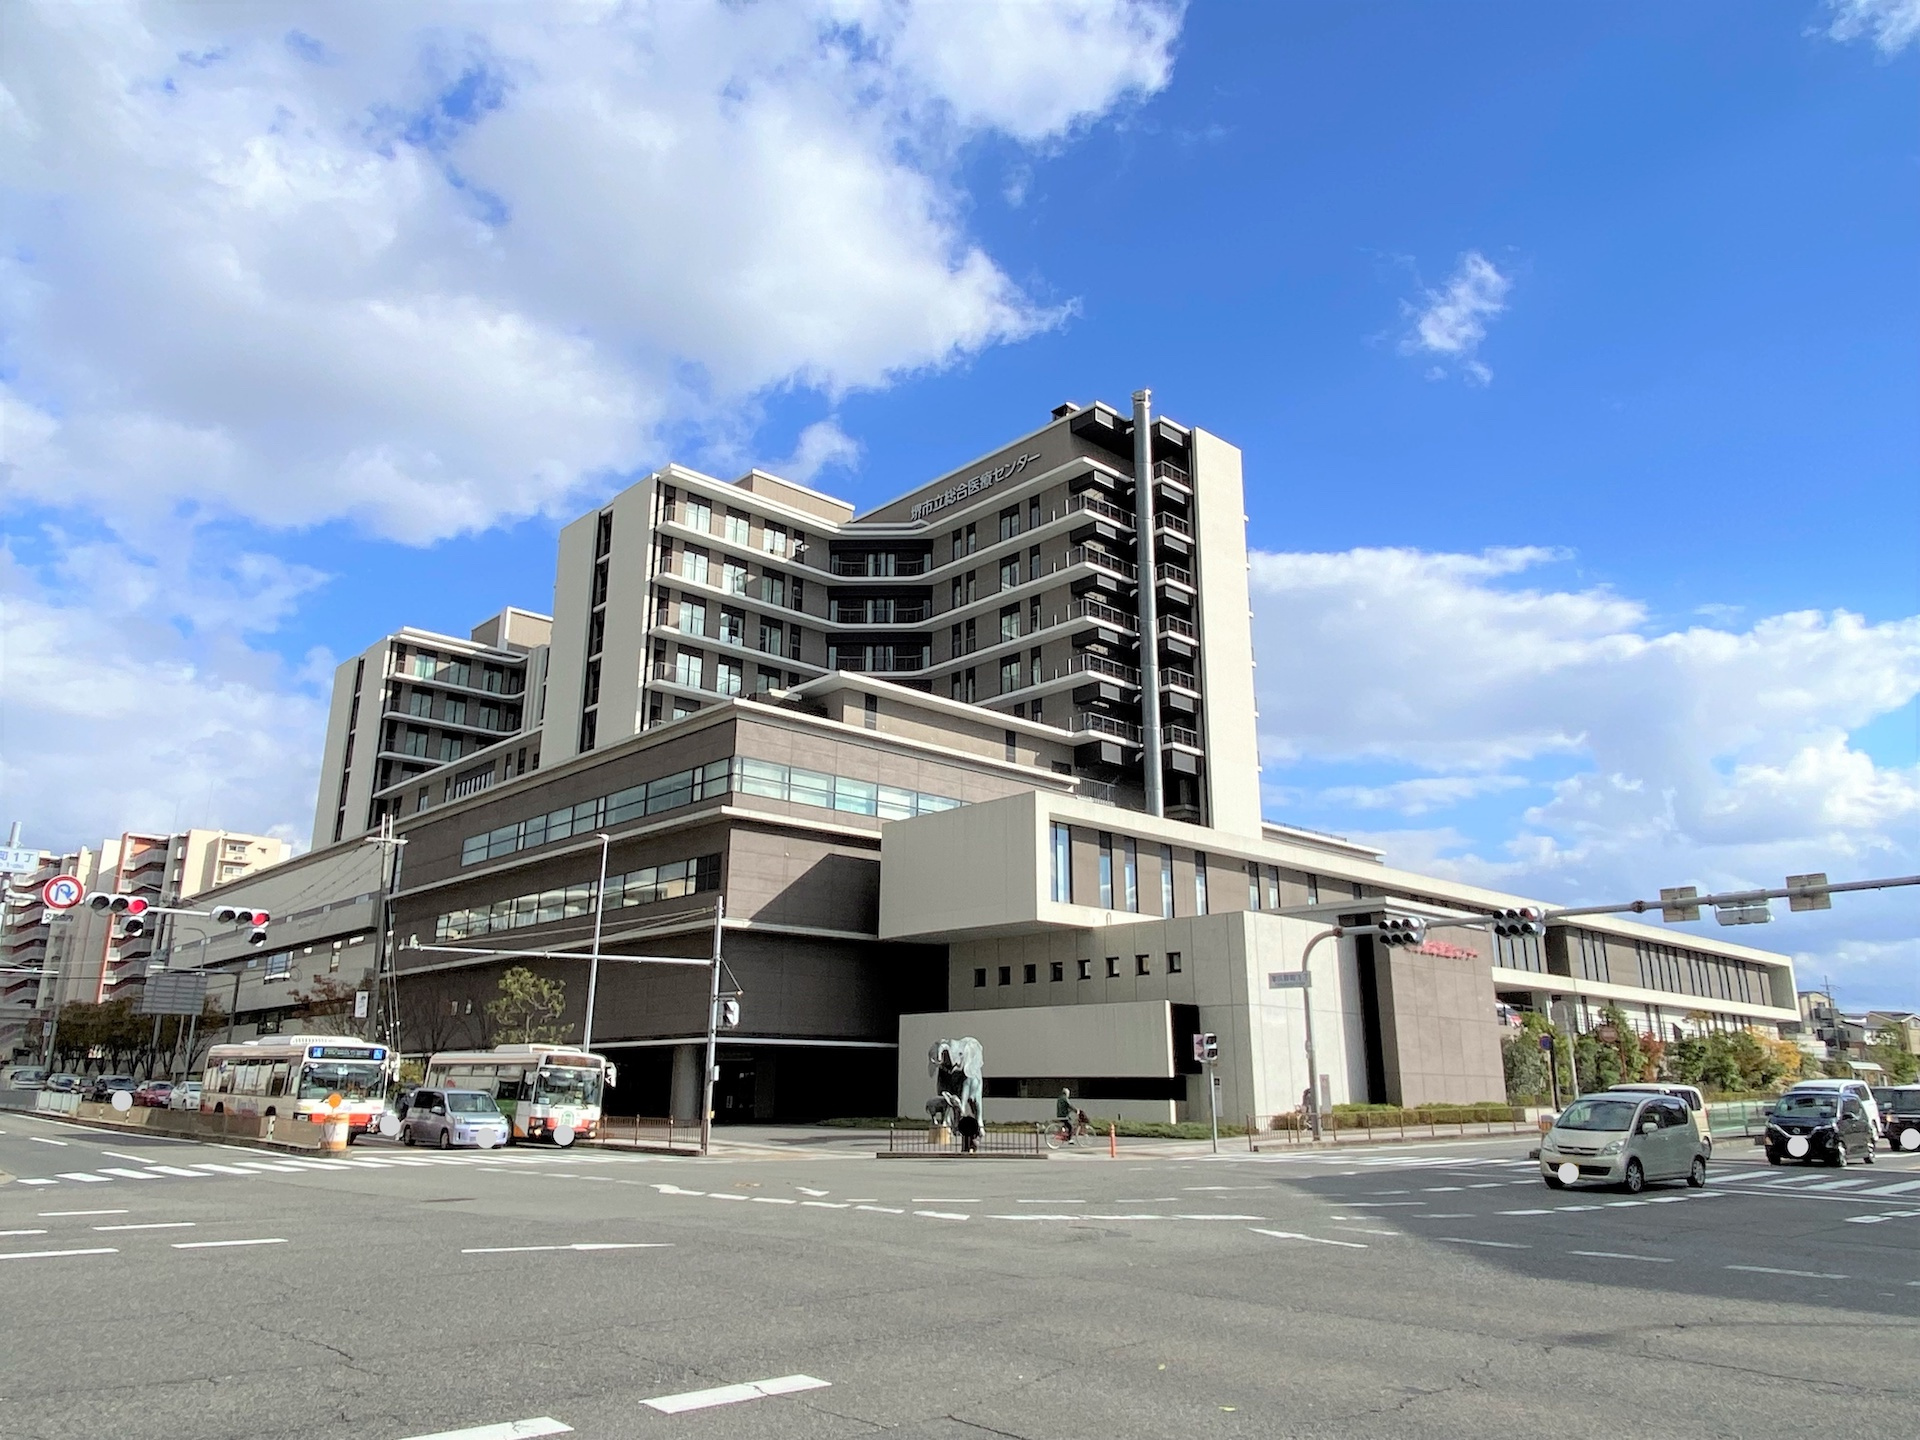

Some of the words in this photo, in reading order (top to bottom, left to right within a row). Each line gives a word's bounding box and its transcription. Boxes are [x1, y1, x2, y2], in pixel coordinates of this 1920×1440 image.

[911, 453, 1041, 521] 堺市立総合医療センター
